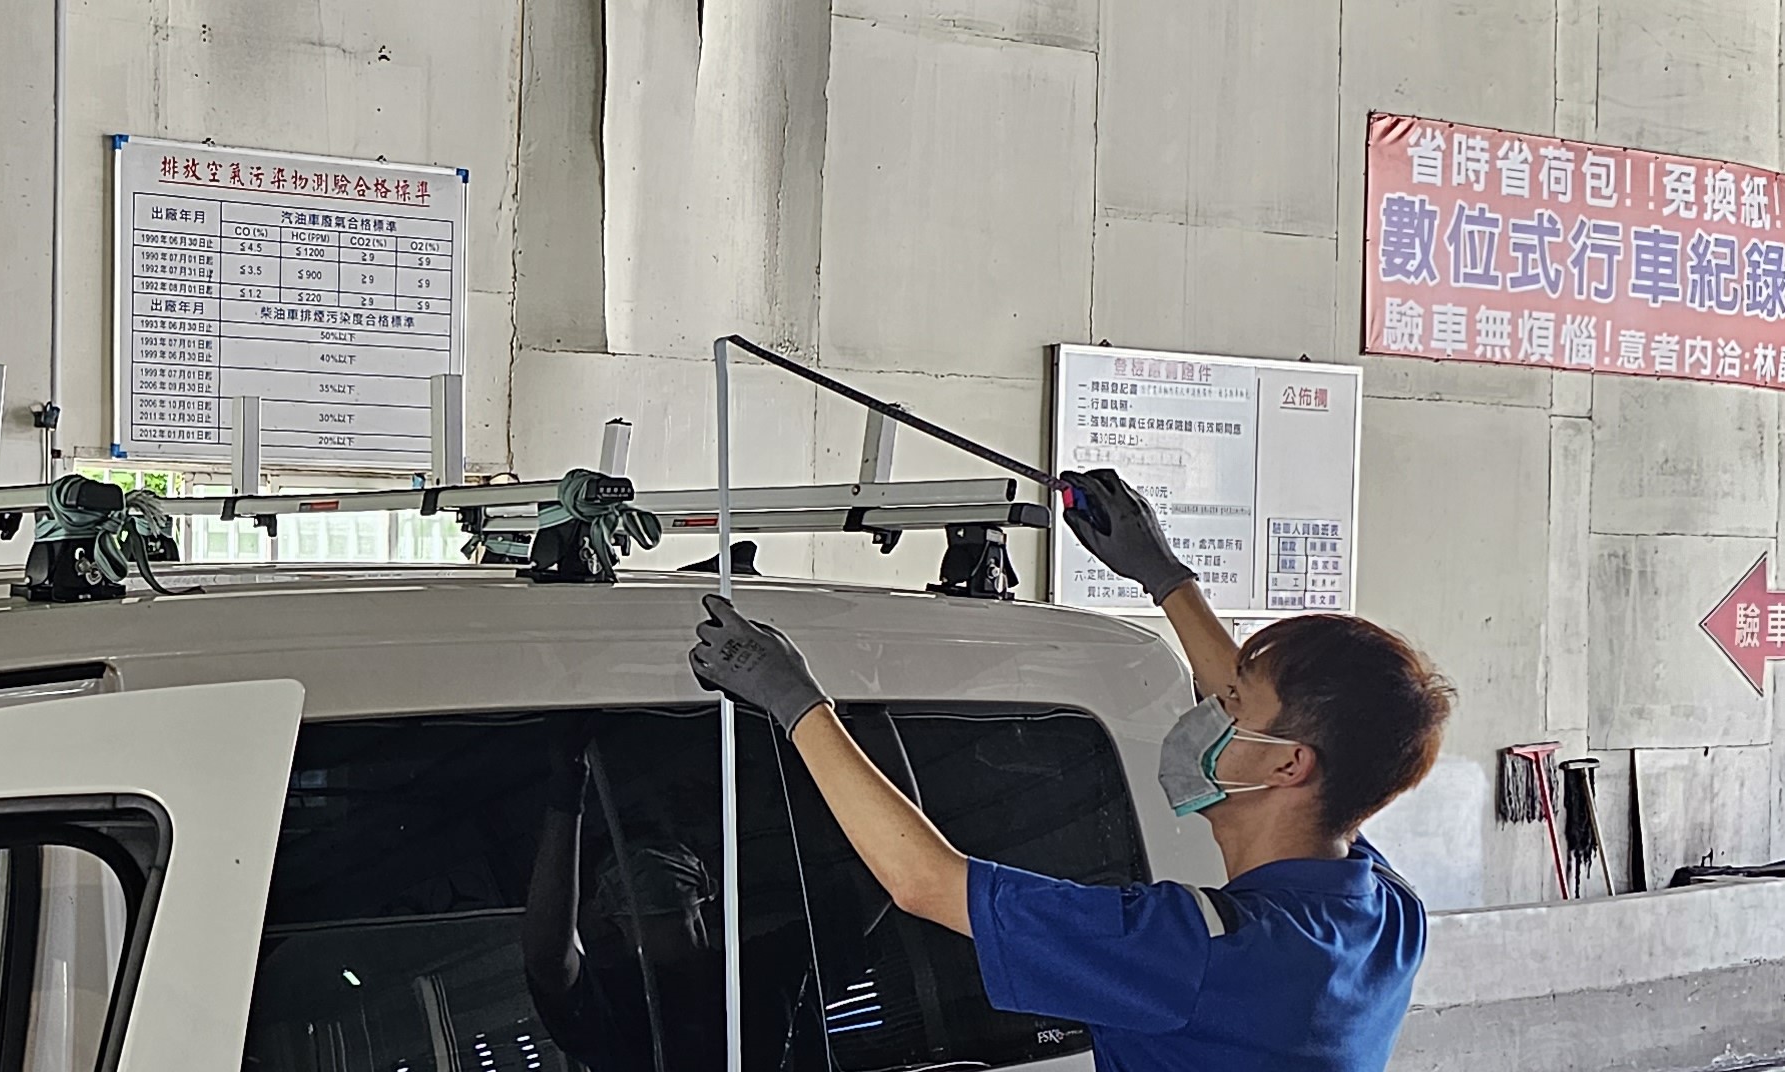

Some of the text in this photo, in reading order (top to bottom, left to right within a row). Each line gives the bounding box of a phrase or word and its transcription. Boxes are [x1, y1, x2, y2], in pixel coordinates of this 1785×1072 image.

[151, 206, 206, 223] 出廠年月
[150, 298, 204, 315] 出廠年月
